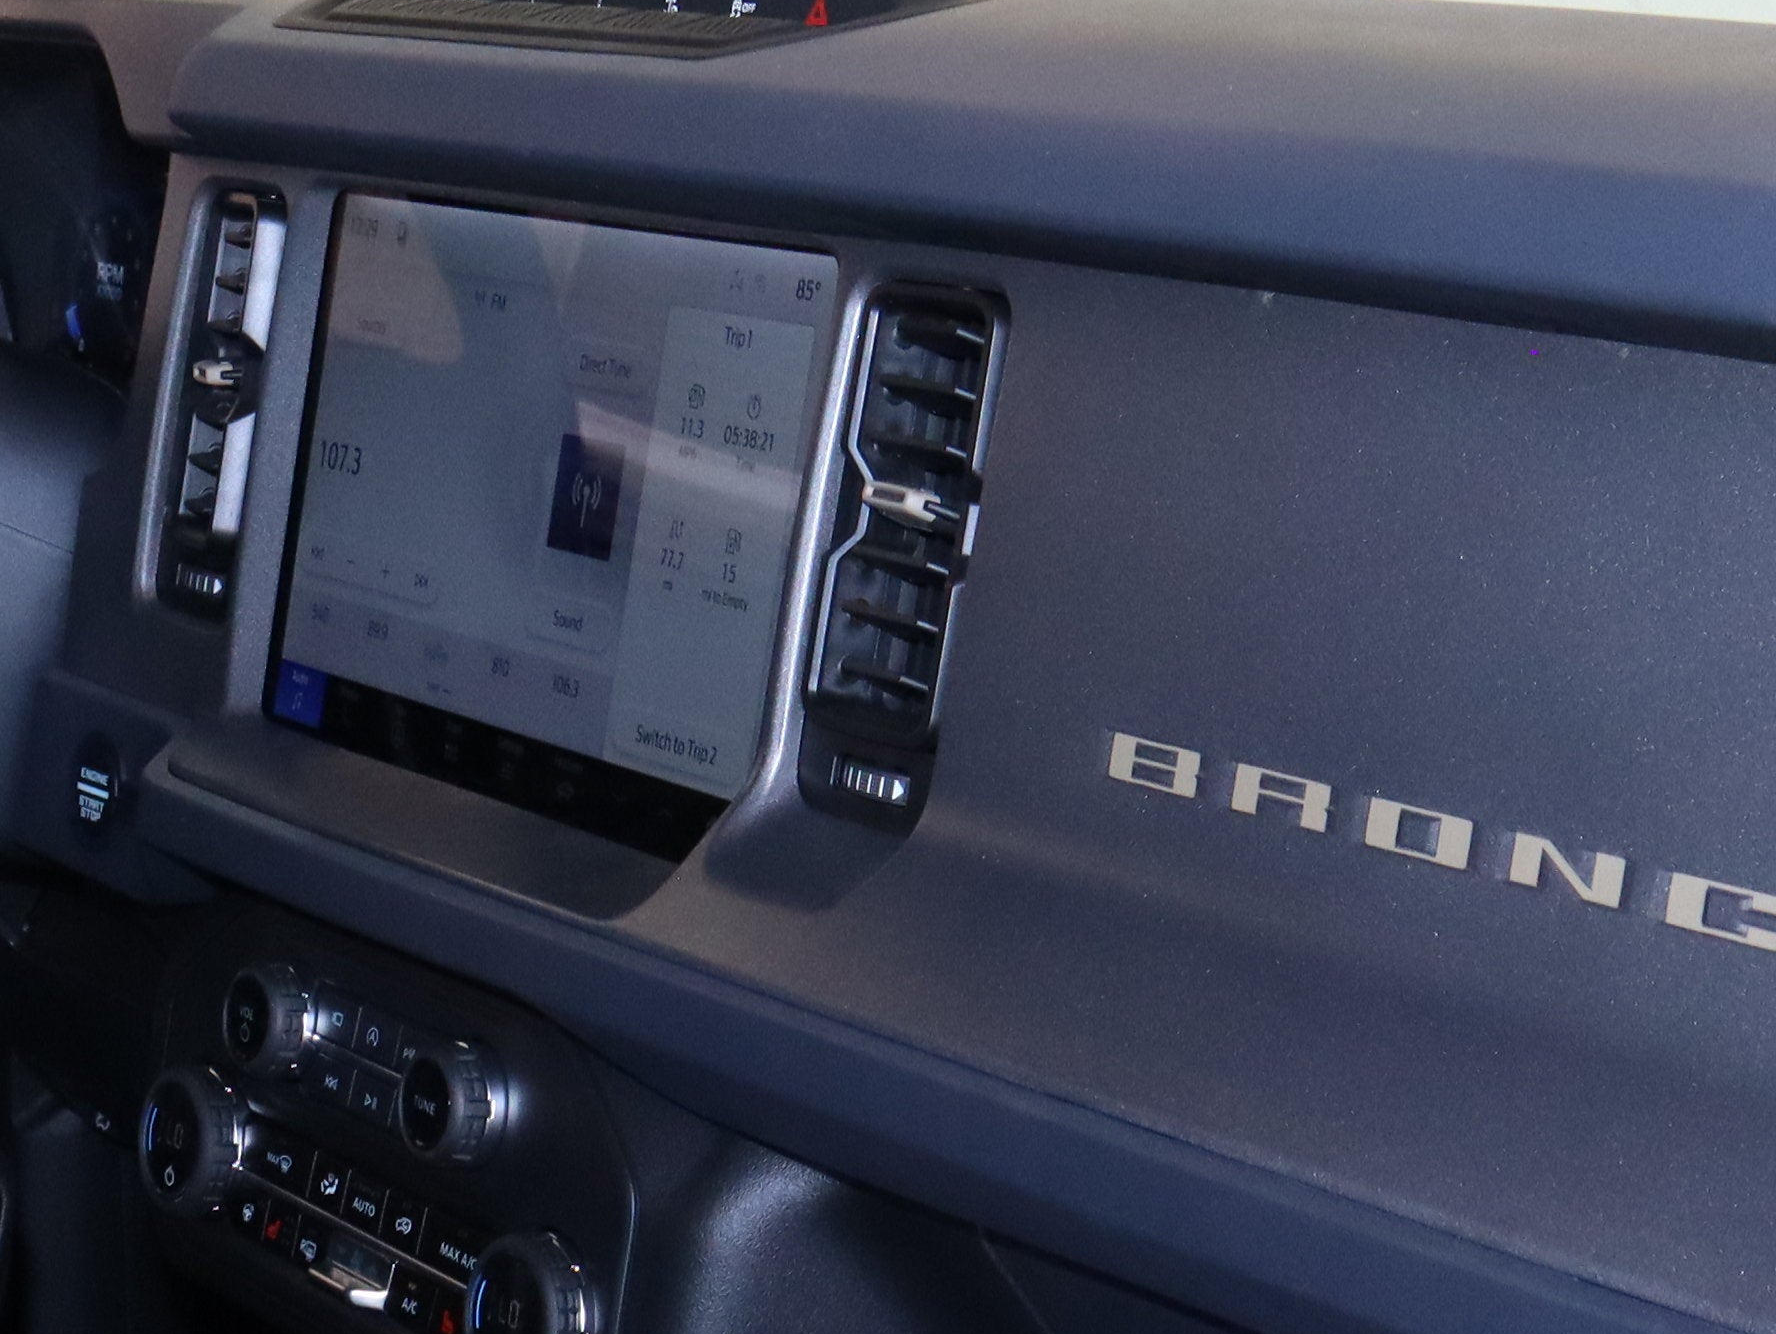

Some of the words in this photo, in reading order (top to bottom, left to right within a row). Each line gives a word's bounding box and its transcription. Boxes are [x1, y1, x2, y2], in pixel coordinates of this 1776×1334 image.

[725, 326, 746, 349] Trip
[723, 424, 776, 452] 05:38:21
[553, 609, 583, 632] Sound
[635, 723, 671, 752] Switch
[673, 736, 685, 755] to
[687, 739, 709, 765] Trip
[352, 1196, 376, 1218] AUTO
[439, 1241, 460, 1264] MAX
[401, 1297, 418, 1316] A/C
